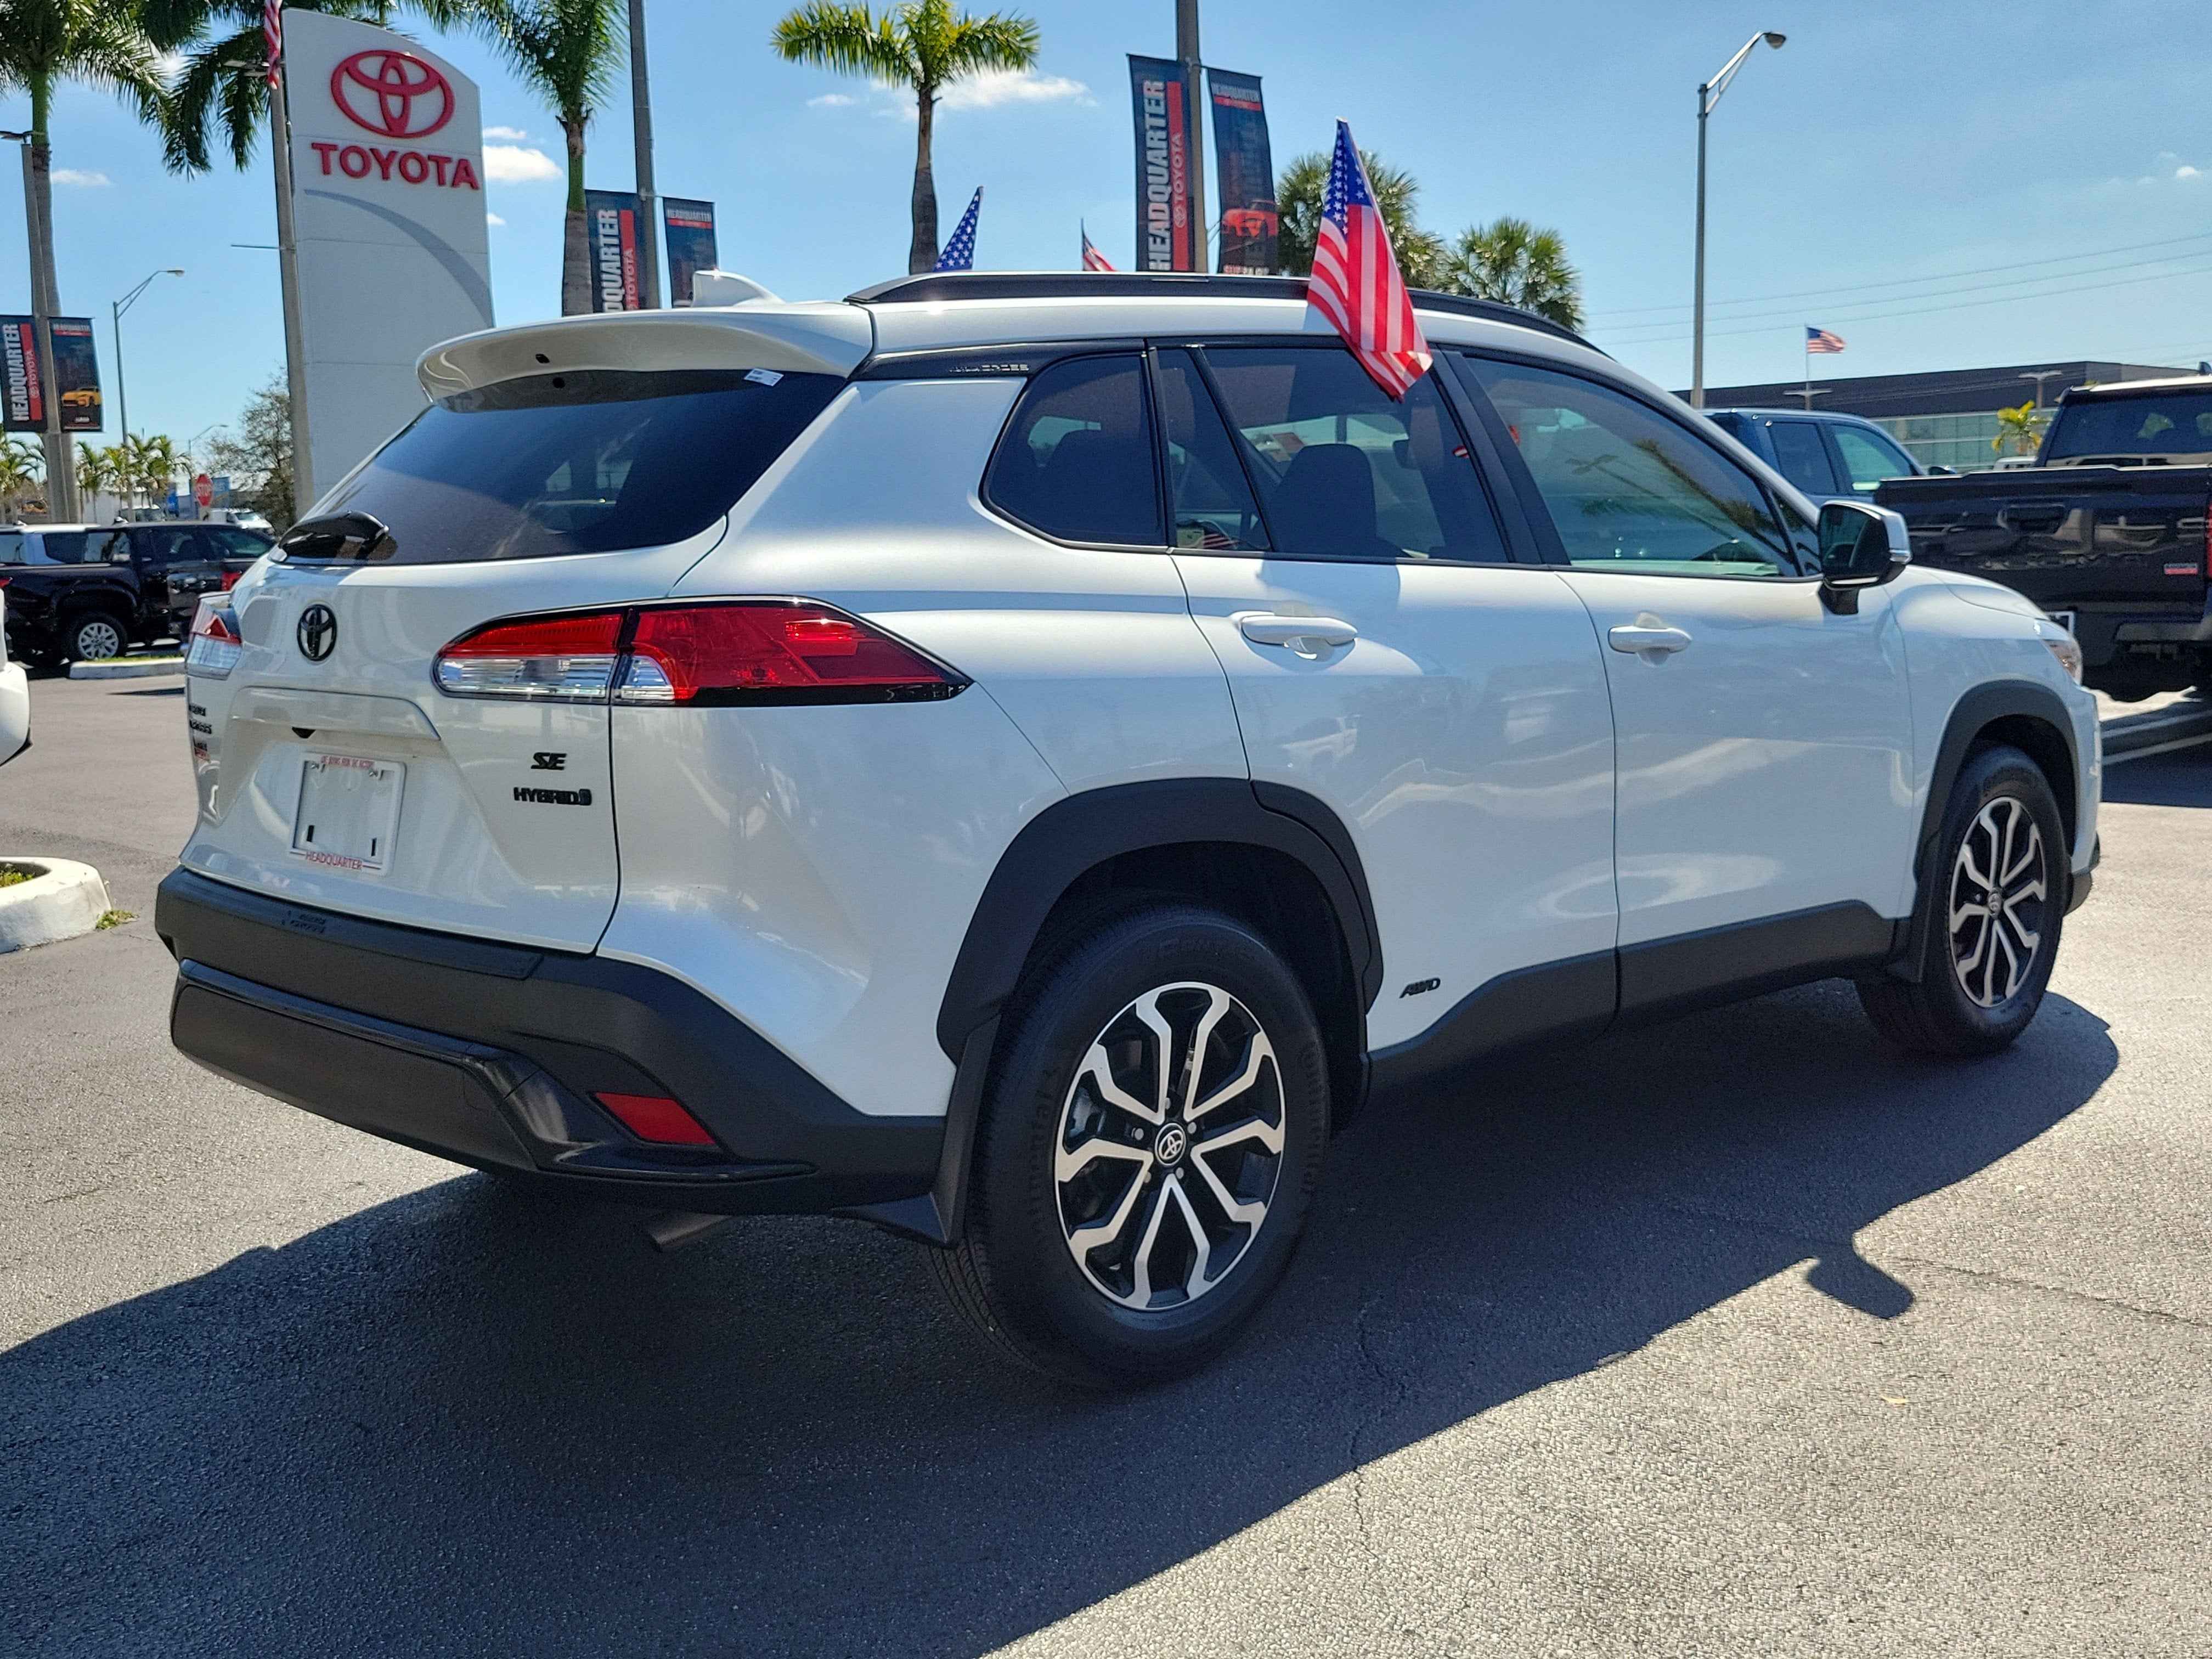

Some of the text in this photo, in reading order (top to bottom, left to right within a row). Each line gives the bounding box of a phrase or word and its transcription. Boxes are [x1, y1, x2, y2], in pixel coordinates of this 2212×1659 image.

[311, 142, 480, 190] TOYOTA
[1143, 81, 1172, 271] HEADQUARTER
[1170, 134, 1184, 205] TOYOTA
[598, 209, 624, 312] DQUARTER
[623, 248, 636, 301] TOYOTA
[2, 324, 29, 421] HEADQUARTER
[196, 483, 213, 496] STOP
[530, 752, 567, 770] SE
[513, 787, 580, 805] HYBRID
[306, 850, 362, 871] HEADQUARTER
